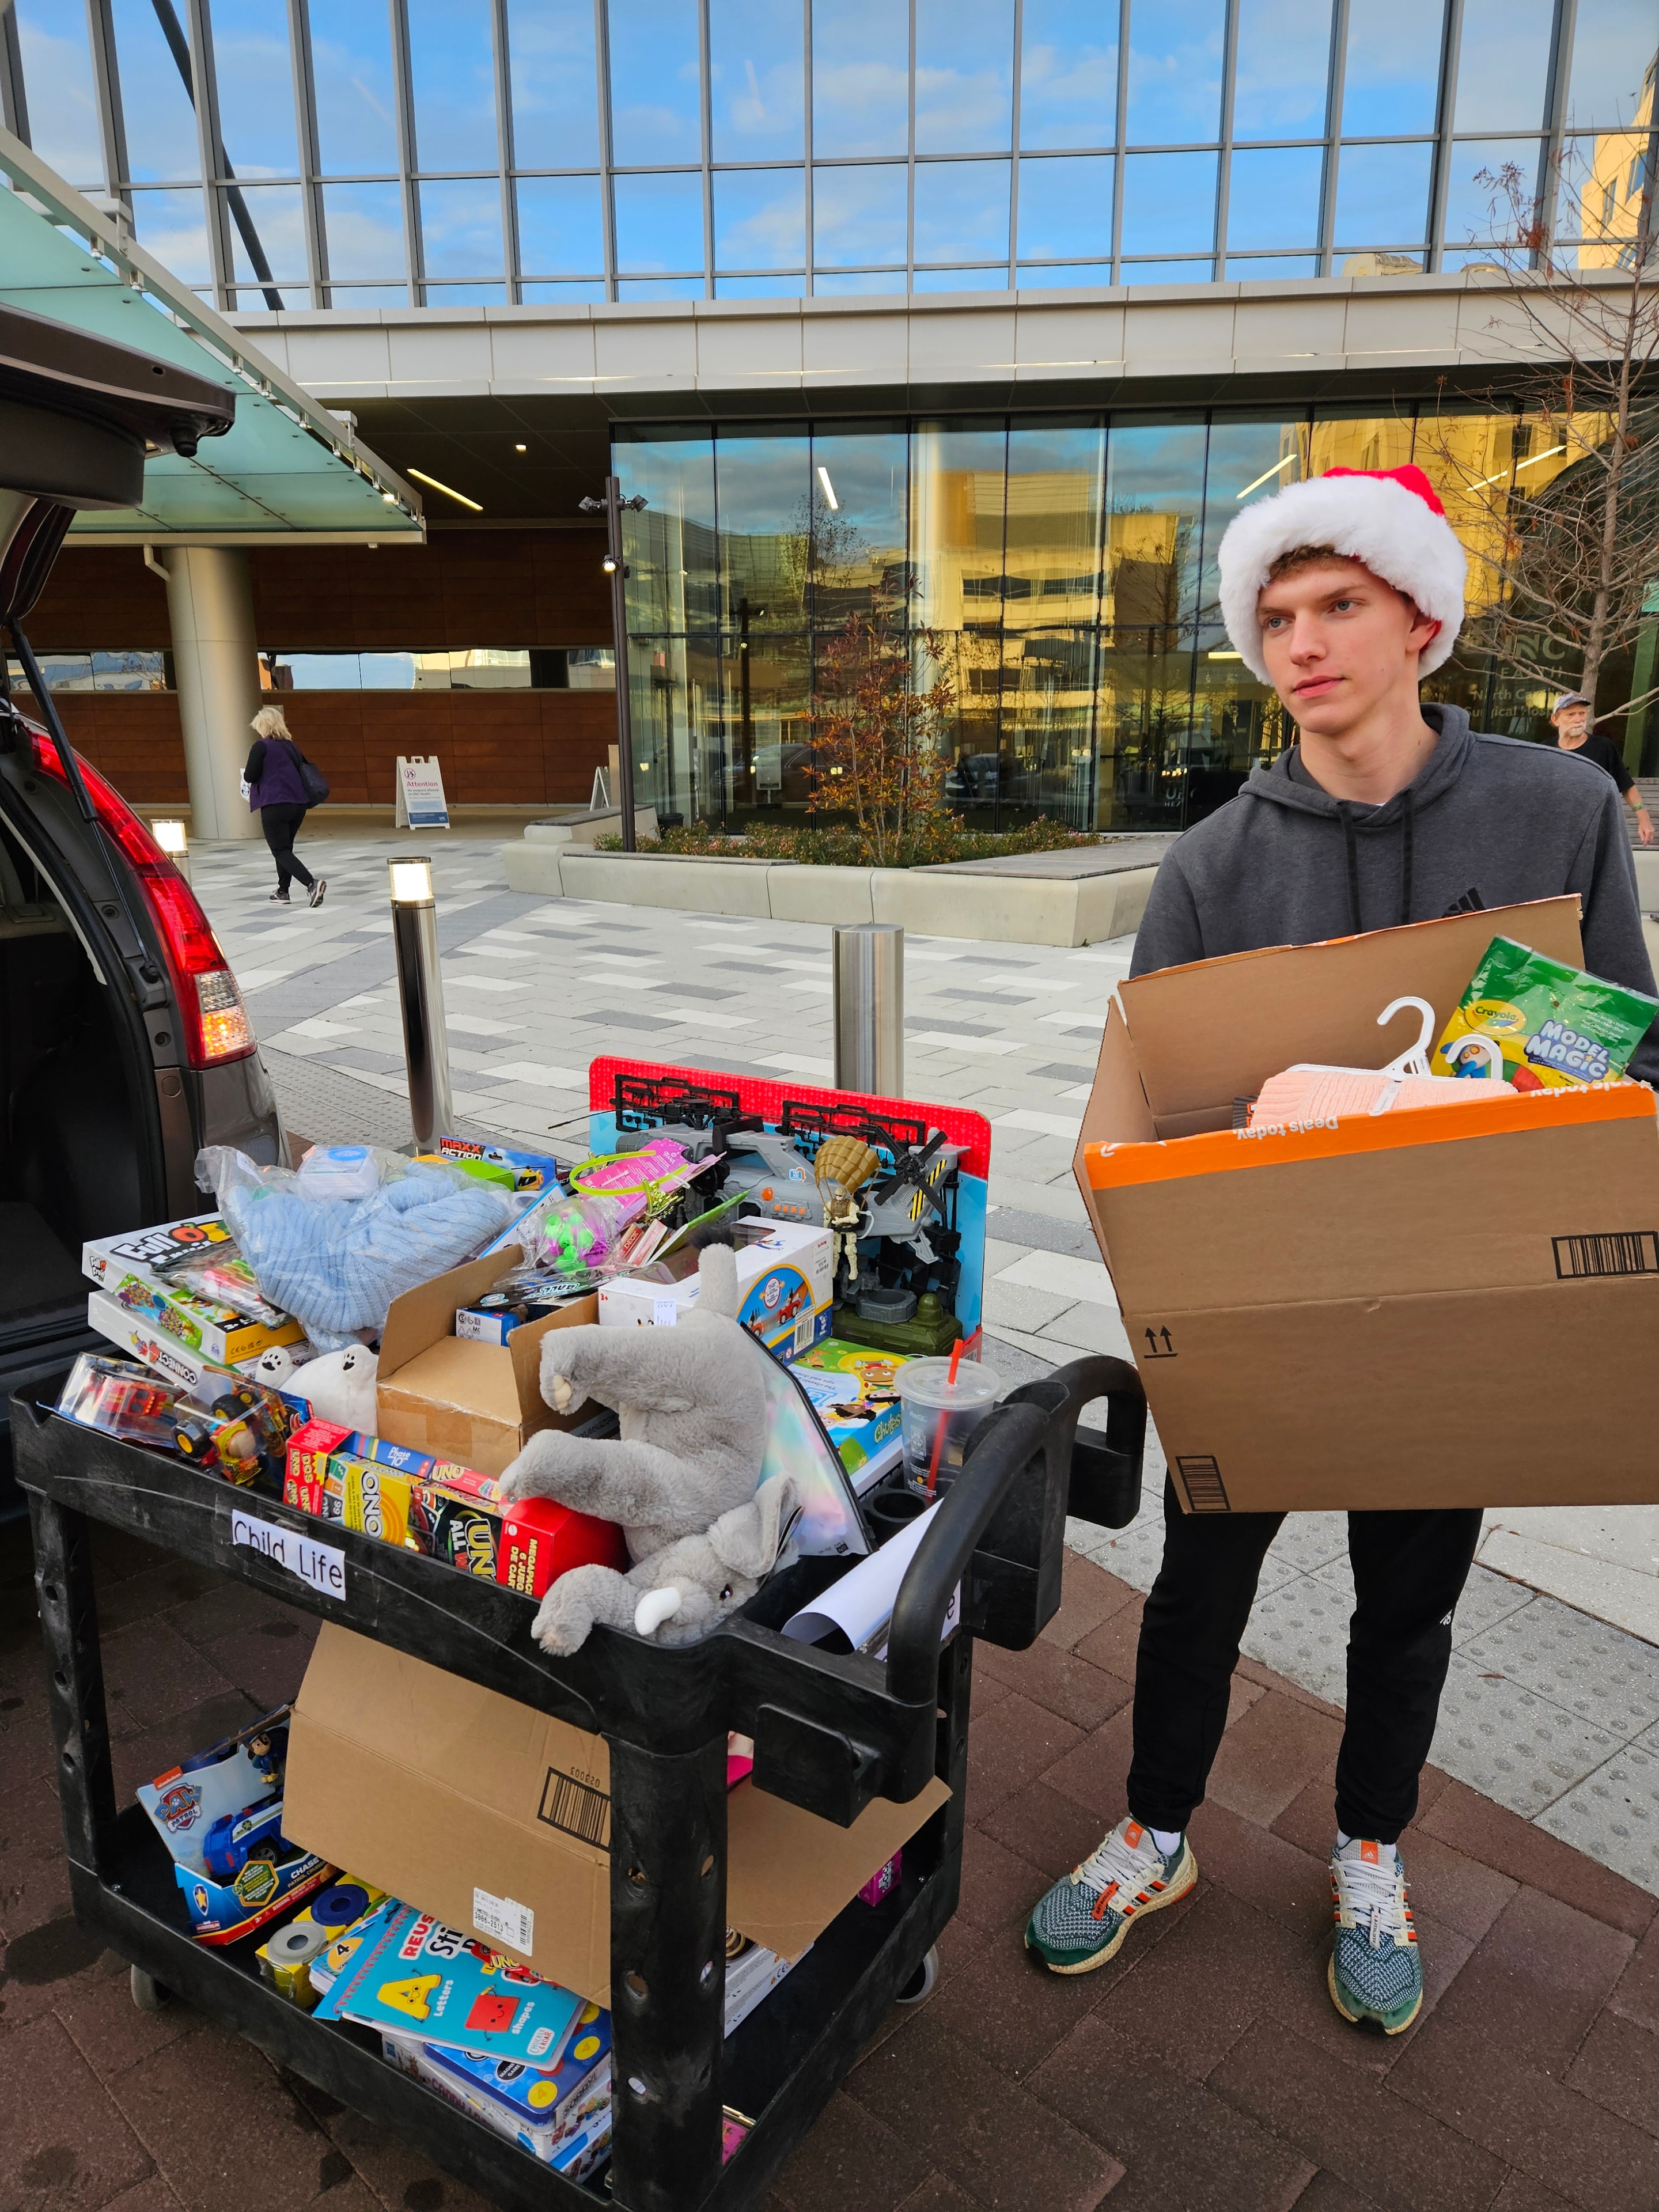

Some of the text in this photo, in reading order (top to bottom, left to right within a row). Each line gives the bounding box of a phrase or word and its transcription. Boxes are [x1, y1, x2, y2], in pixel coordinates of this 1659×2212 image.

[1473, 690, 1512, 700] Nrth
[1475, 1007, 1517, 1021] Crayola
[1541, 1021, 1608, 1064] MODEL
[1527, 1035, 1606, 1077] MAGIC
[1233, 1116, 1339, 1140] Deals today.
[441, 1139, 481, 1153] MAXX
[441, 1147, 482, 1160] ACTION
[113, 1234, 181, 1260] Full
[624, 1232, 639, 1249] DECK
[158, 1351, 197, 1384] CONNECT
[874, 1412, 902, 1444] Chutes
[389, 1446, 411, 1458] Phase
[391, 1457, 404, 1467] 10
[301, 1453, 313, 1483] DOS
[432, 1464, 465, 1482] UNO
[362, 1471, 383, 1539] ONO
[450, 1520, 467, 1551] ALL
[234, 1520, 342, 1588] Child Life
[467, 1522, 496, 1581] UN
[510, 1546, 519, 1562] DE
[520, 1552, 527, 1560] 6
[570, 1767, 600, 1787] 023003
[154, 1786, 203, 1825] PAW
[171, 1809, 198, 1827] PATROL
[290, 1857, 320, 1879] CHASE
[287, 1874, 307, 1888] PATROL
[255, 1916, 263, 1924] 3+
[337, 1944, 350, 1956] 4
[434, 1980, 454, 2017] Letters
[512, 2001, 535, 2035] shapes
[529, 2028, 546, 2054] CHUCKLE
[543, 2031, 552, 2046] ROAR
